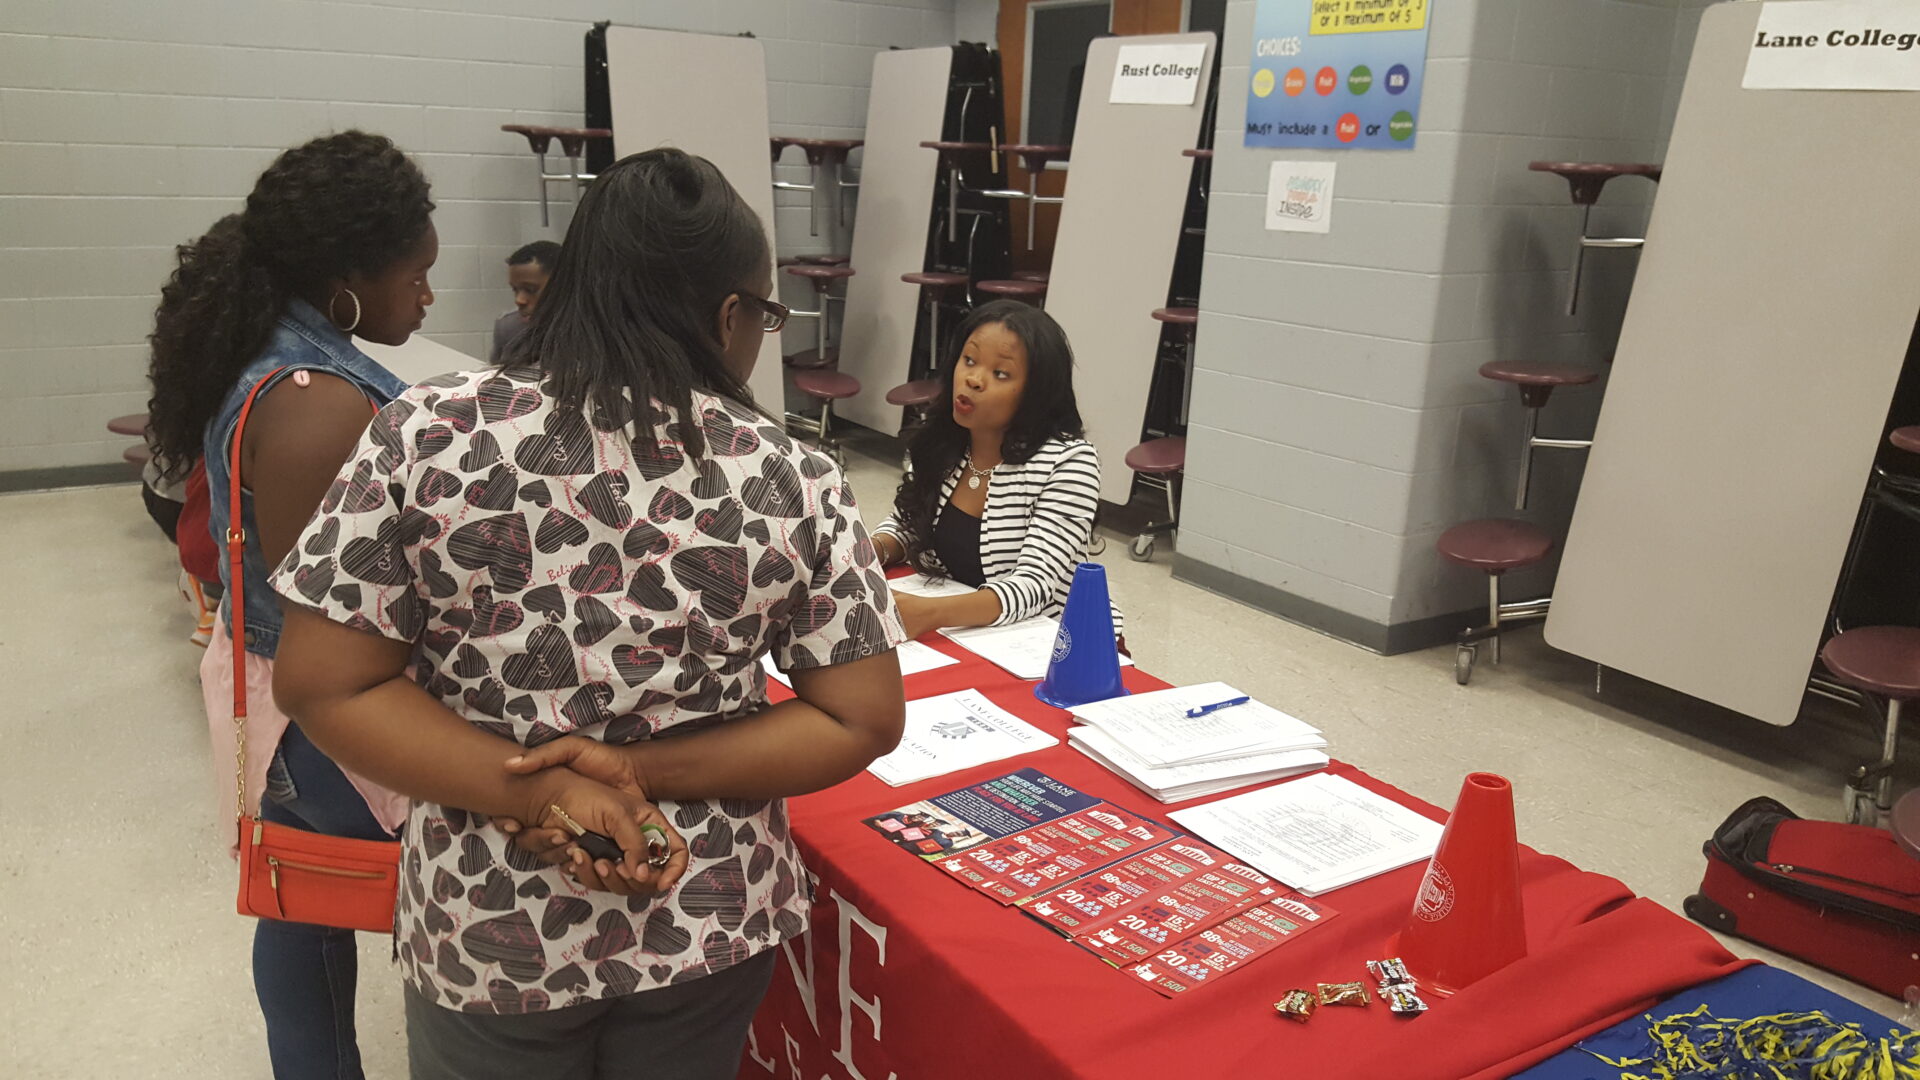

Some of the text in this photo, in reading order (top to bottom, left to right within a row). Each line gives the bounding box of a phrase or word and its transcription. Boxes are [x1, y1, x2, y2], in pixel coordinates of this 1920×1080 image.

[1320, 15, 1330, 27] or
[1343, 12, 1385, 25] maximum
[1389, 10, 1401, 23] of
[1405, 9, 1412, 23] 5
[1755, 29, 1920, 51] Lane Colleg
[1121, 63, 1199, 79] Rust College
[1246, 122, 1272, 136] Must
[1278, 122, 1317, 136] include
[1365, 124, 1381, 137] or
[969, 849, 994, 861] 20
[1014, 851, 1038, 863] 15:1
[1150, 853, 1166, 861] TOP
[1044, 864, 1069, 877] 15:1
[1203, 873, 1220, 881] TOP
[1057, 890, 1084, 903] 20
[1104, 891, 1131, 905] 15:1
[1054, 913, 1079, 926] 1,500
[1119, 915, 1146, 930] 20
[1168, 915, 1194, 929] 15:1
[1200, 931, 1224, 945] 98%
[1120, 940, 1148, 955] 1,500
[1157, 950, 1186, 966] 20
[1208, 952, 1237, 968] 15:1
[1157, 977, 1186, 992] 1,500
